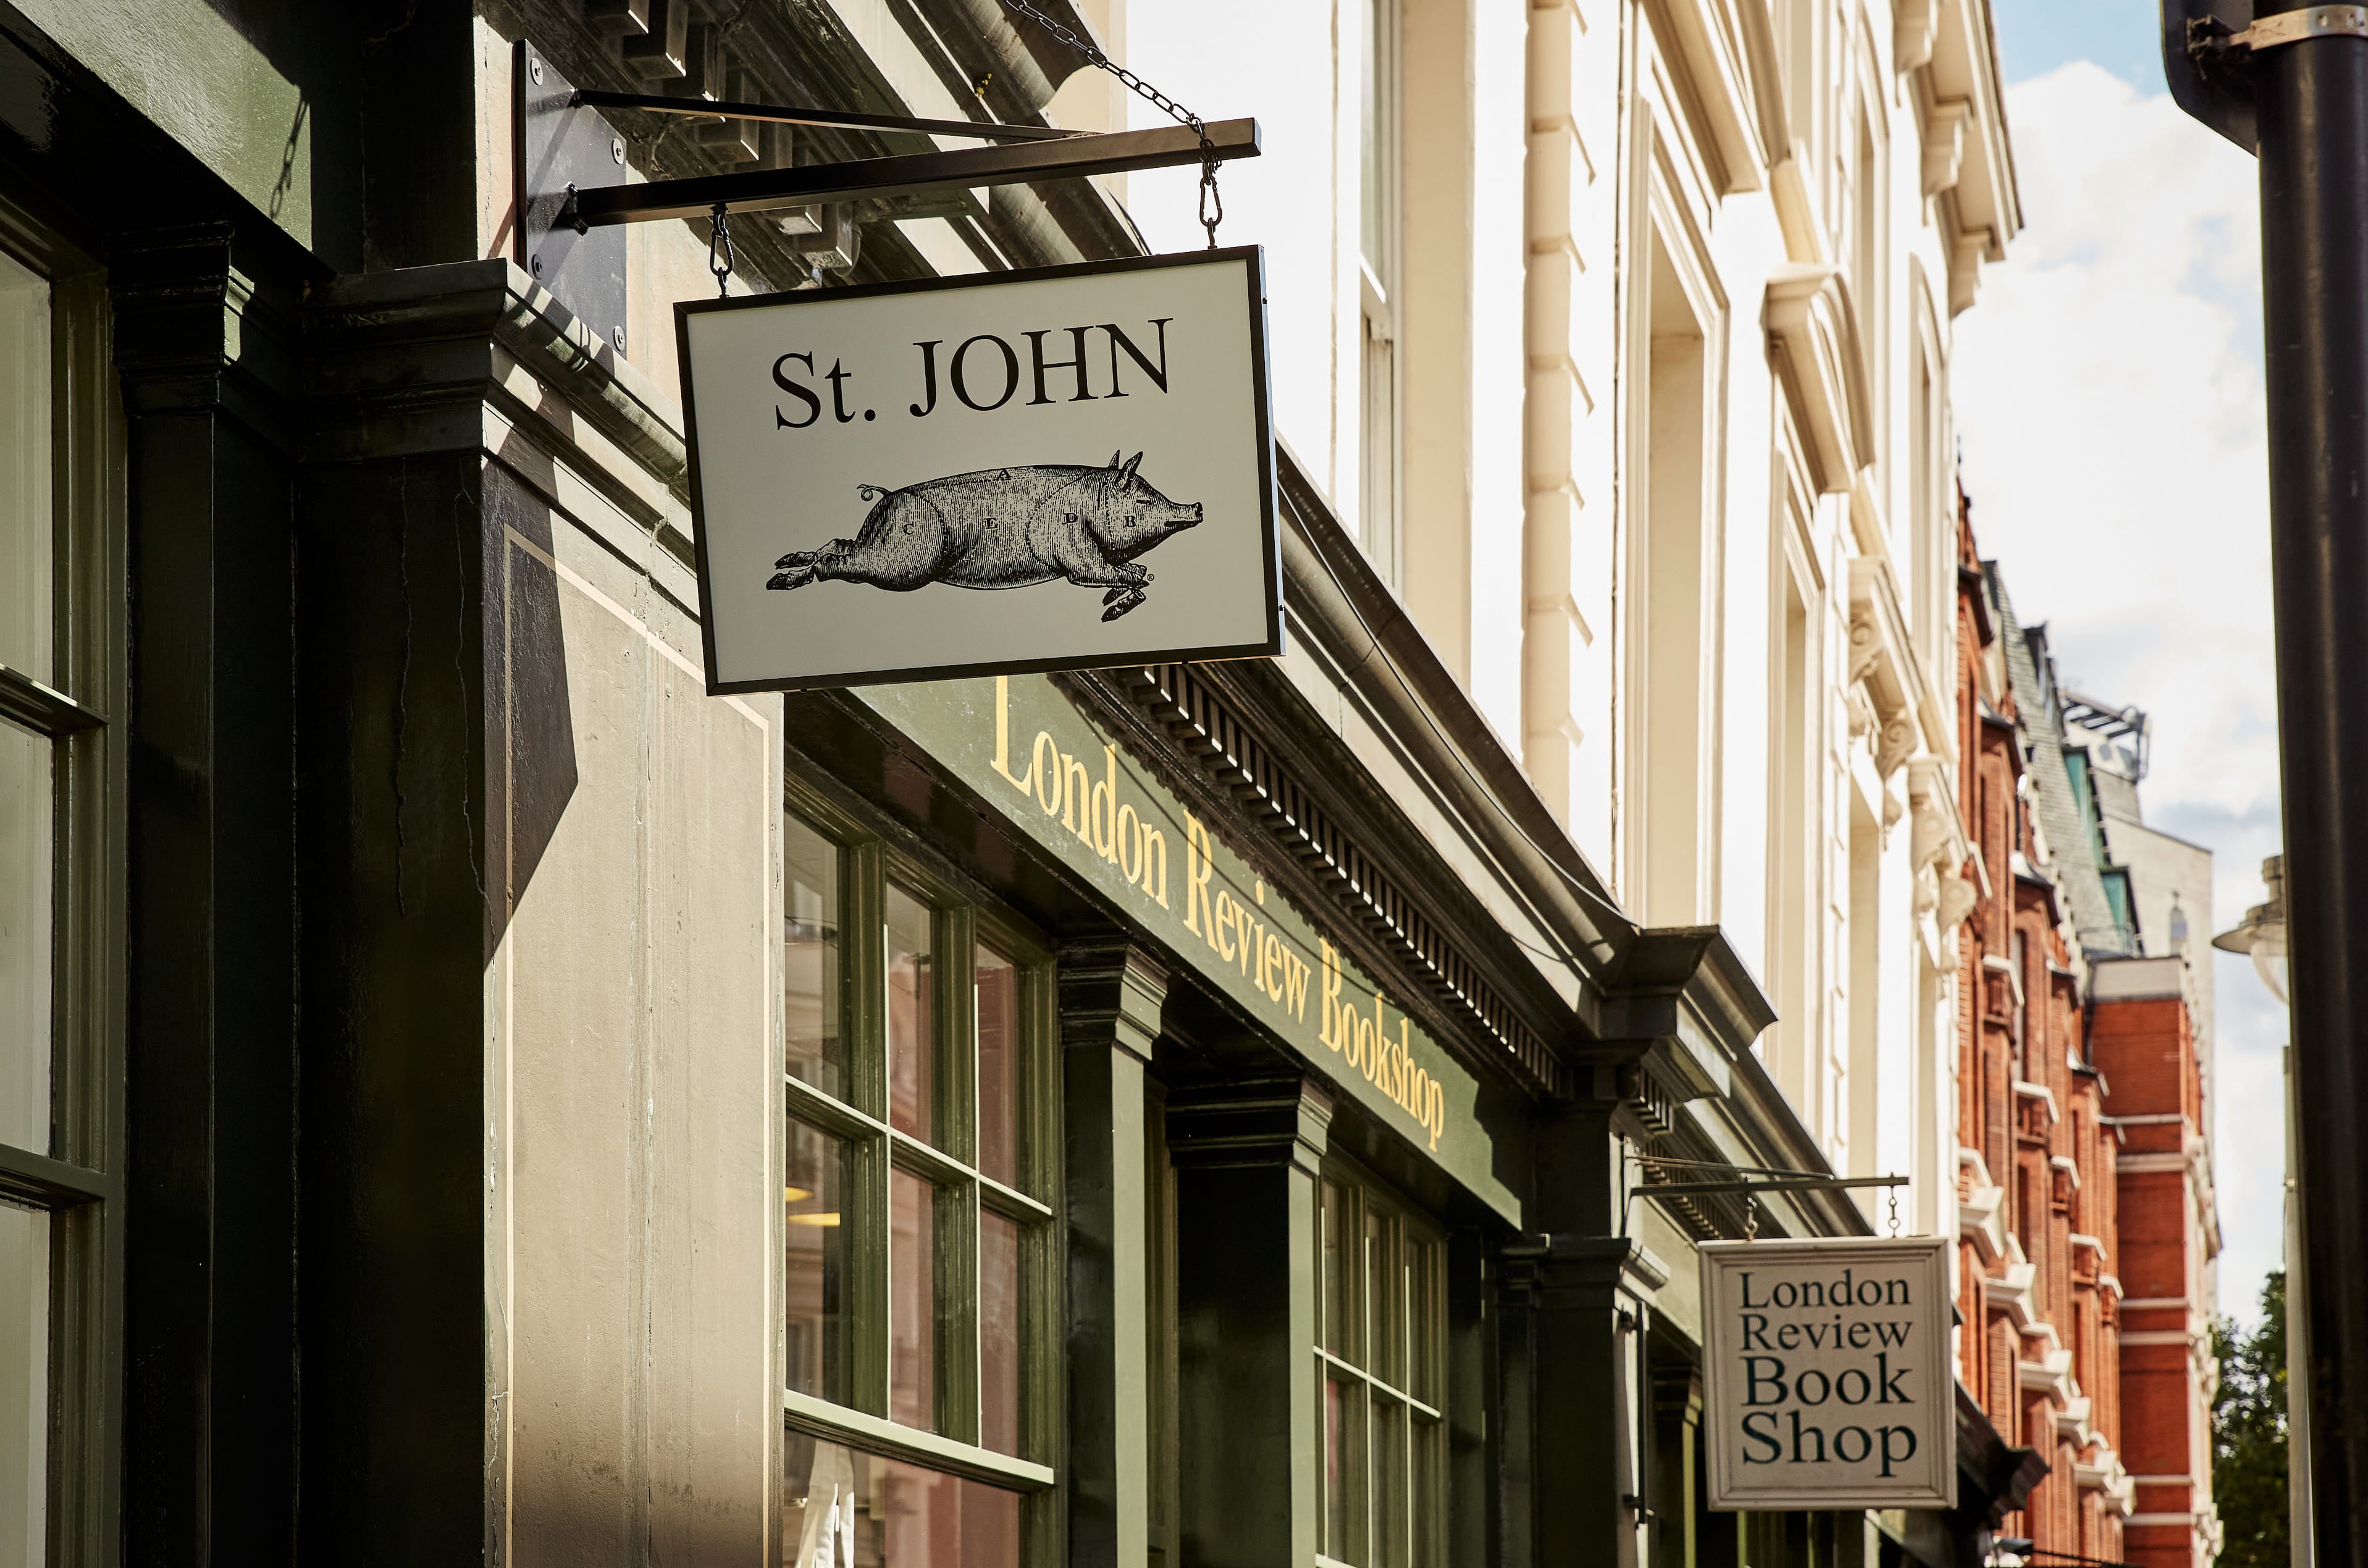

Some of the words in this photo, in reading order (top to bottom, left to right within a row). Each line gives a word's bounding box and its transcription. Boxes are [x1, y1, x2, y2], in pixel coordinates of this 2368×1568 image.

[772, 351, 876, 430] St.
[909, 317, 1174, 418] JOHN
[1062, 512, 1078, 525] D
[991, 676, 1169, 911] London
[1182, 808, 1312, 1023] Review
[1317, 937, 1445, 1153] Bookshop
[1737, 1268, 1911, 1309] London
[1739, 1314, 1913, 1351] Review
[1740, 1352, 1915, 1407] Book
[1741, 1409, 1917, 1478] Shop
